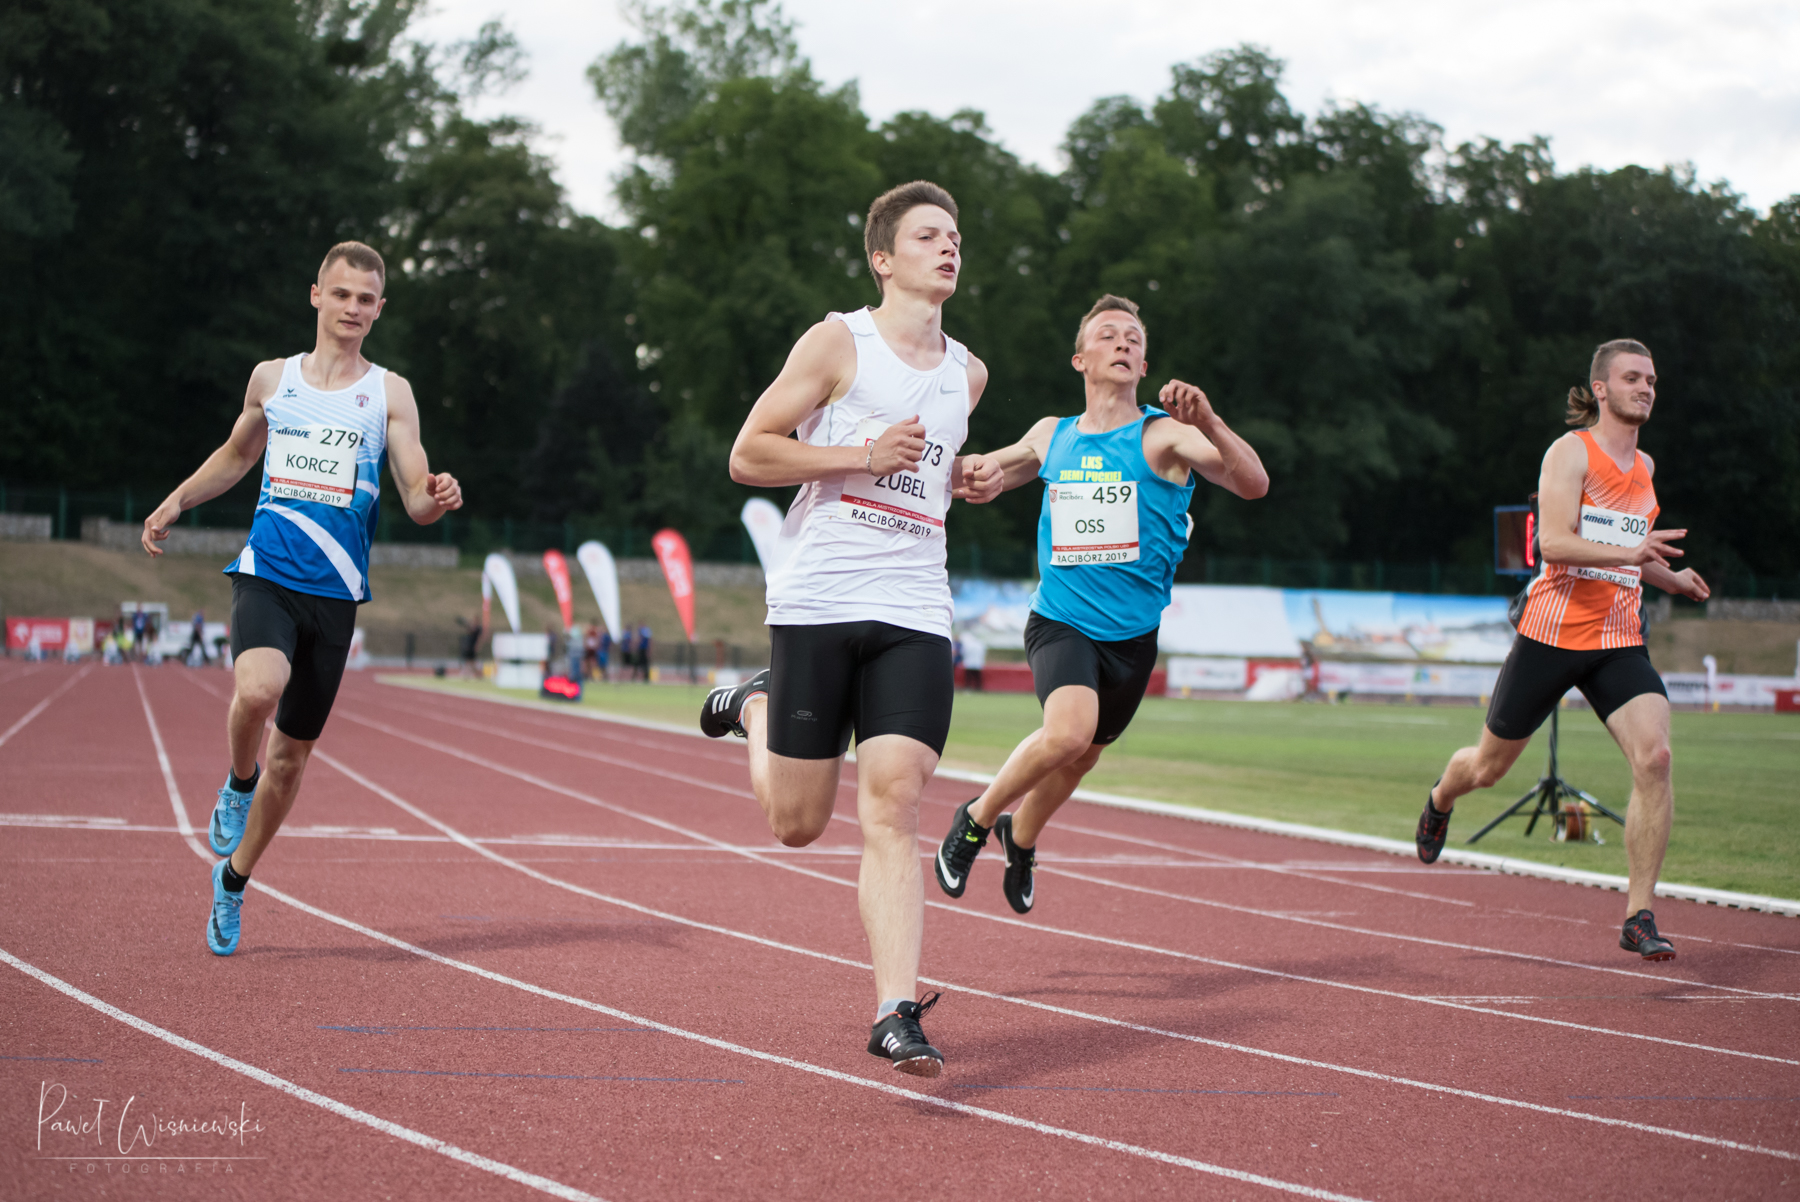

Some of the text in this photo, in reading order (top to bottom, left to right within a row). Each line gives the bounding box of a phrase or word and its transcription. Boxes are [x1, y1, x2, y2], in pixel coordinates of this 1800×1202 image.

[319, 428, 359, 449] 279
[922, 440, 944, 467] 73
[286, 453, 340, 475] KORCZ
[1080, 456, 1104, 470] LKS
[1059, 470, 1122, 482] ZIEMI PUCKIEJ
[273, 486, 341, 504] RACIBÓRZ 2019
[1092, 485, 1132, 504] 459
[878, 504, 911, 517] MISTRZOSTWA
[851, 508, 931, 538] RACIBÓRZ 2019
[1075, 519, 1105, 534] OSS
[1620, 516, 1646, 536] 302
[1057, 552, 1128, 563] RACIBÓRZ 2019
[1577, 568, 1617, 582] RACIBÓRZ
[1619, 576, 1636, 585] 2019
